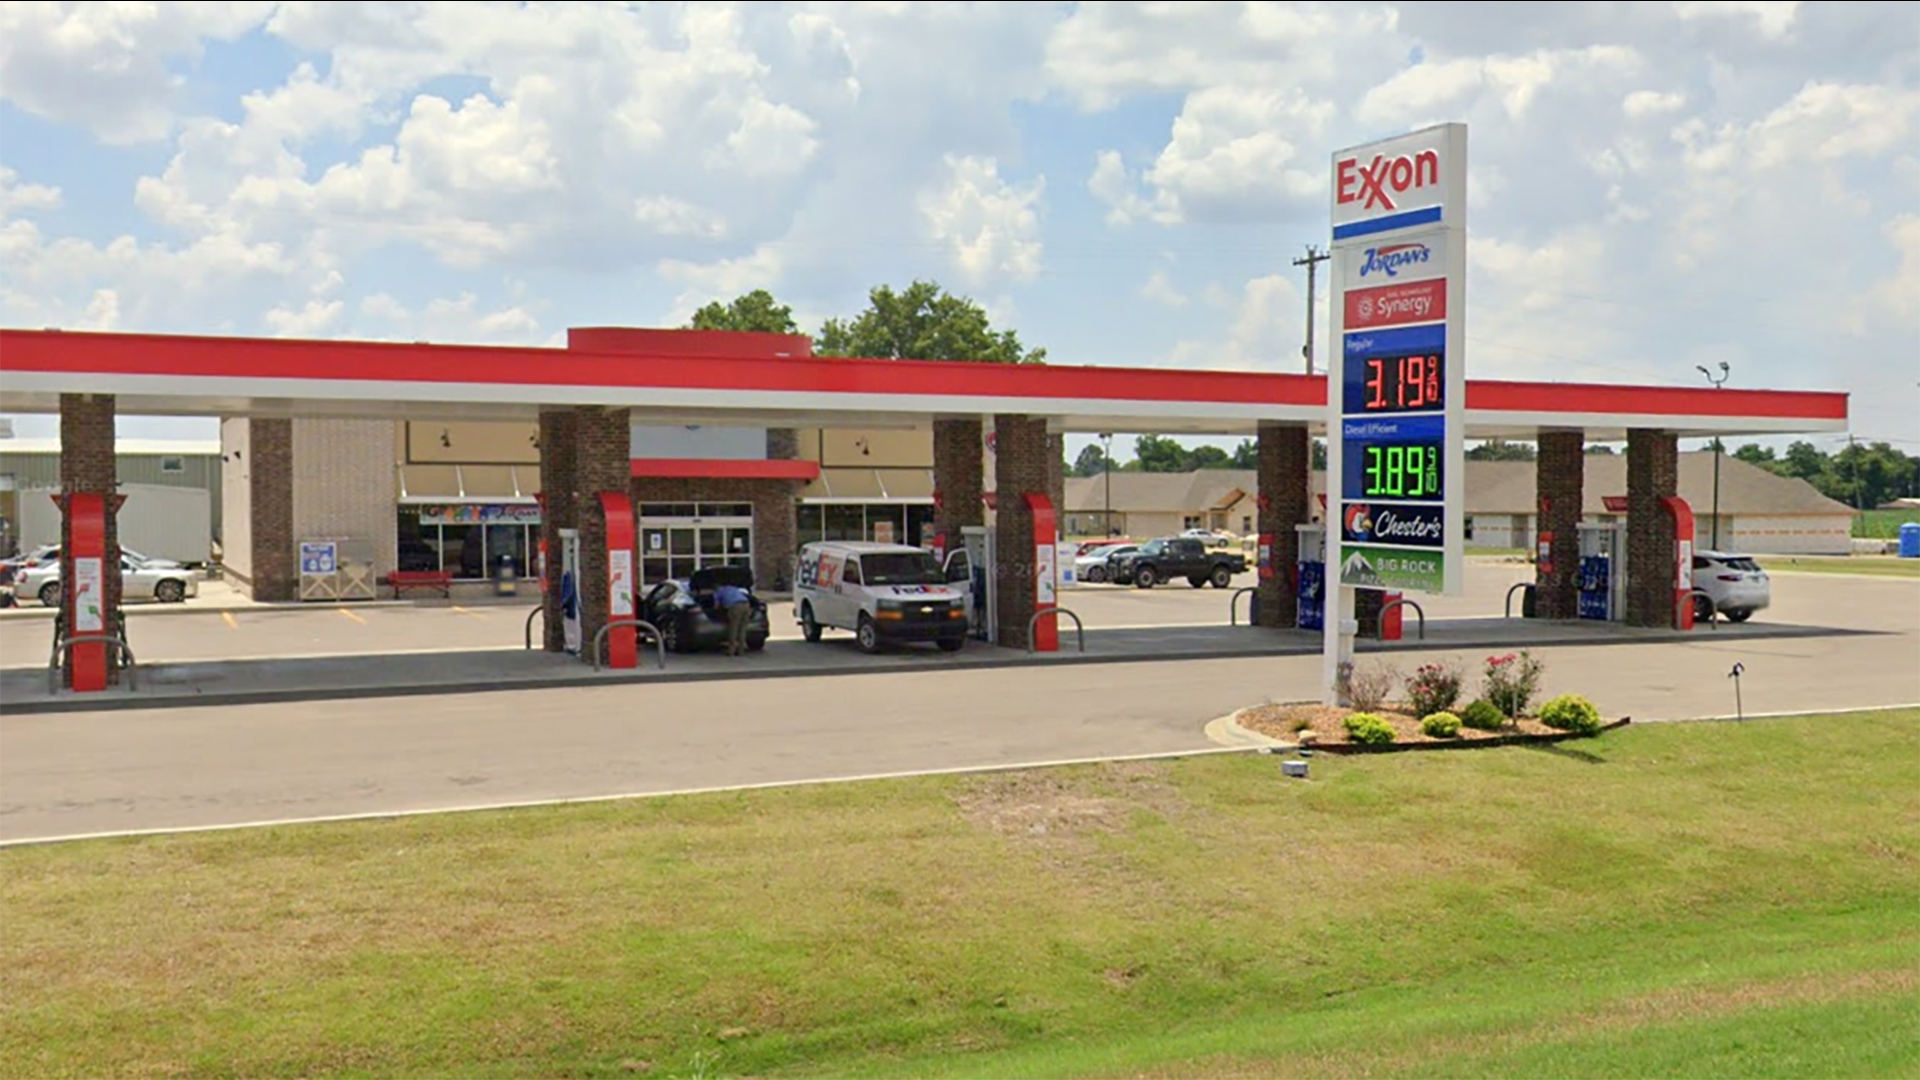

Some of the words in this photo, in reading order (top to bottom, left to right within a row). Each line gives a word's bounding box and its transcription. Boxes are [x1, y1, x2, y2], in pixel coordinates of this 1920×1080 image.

[1337, 149, 1438, 210] Exxon
[1377, 296, 1432, 318] Synergy
[1367, 356, 1424, 408] 3.19
[1345, 423, 1366, 435] Diesel
[1366, 446, 1423, 495] 3.89
[1375, 509, 1441, 538] Chester's
[1377, 558, 1398, 571] BIG
[1401, 560, 1436, 574] ROCK
